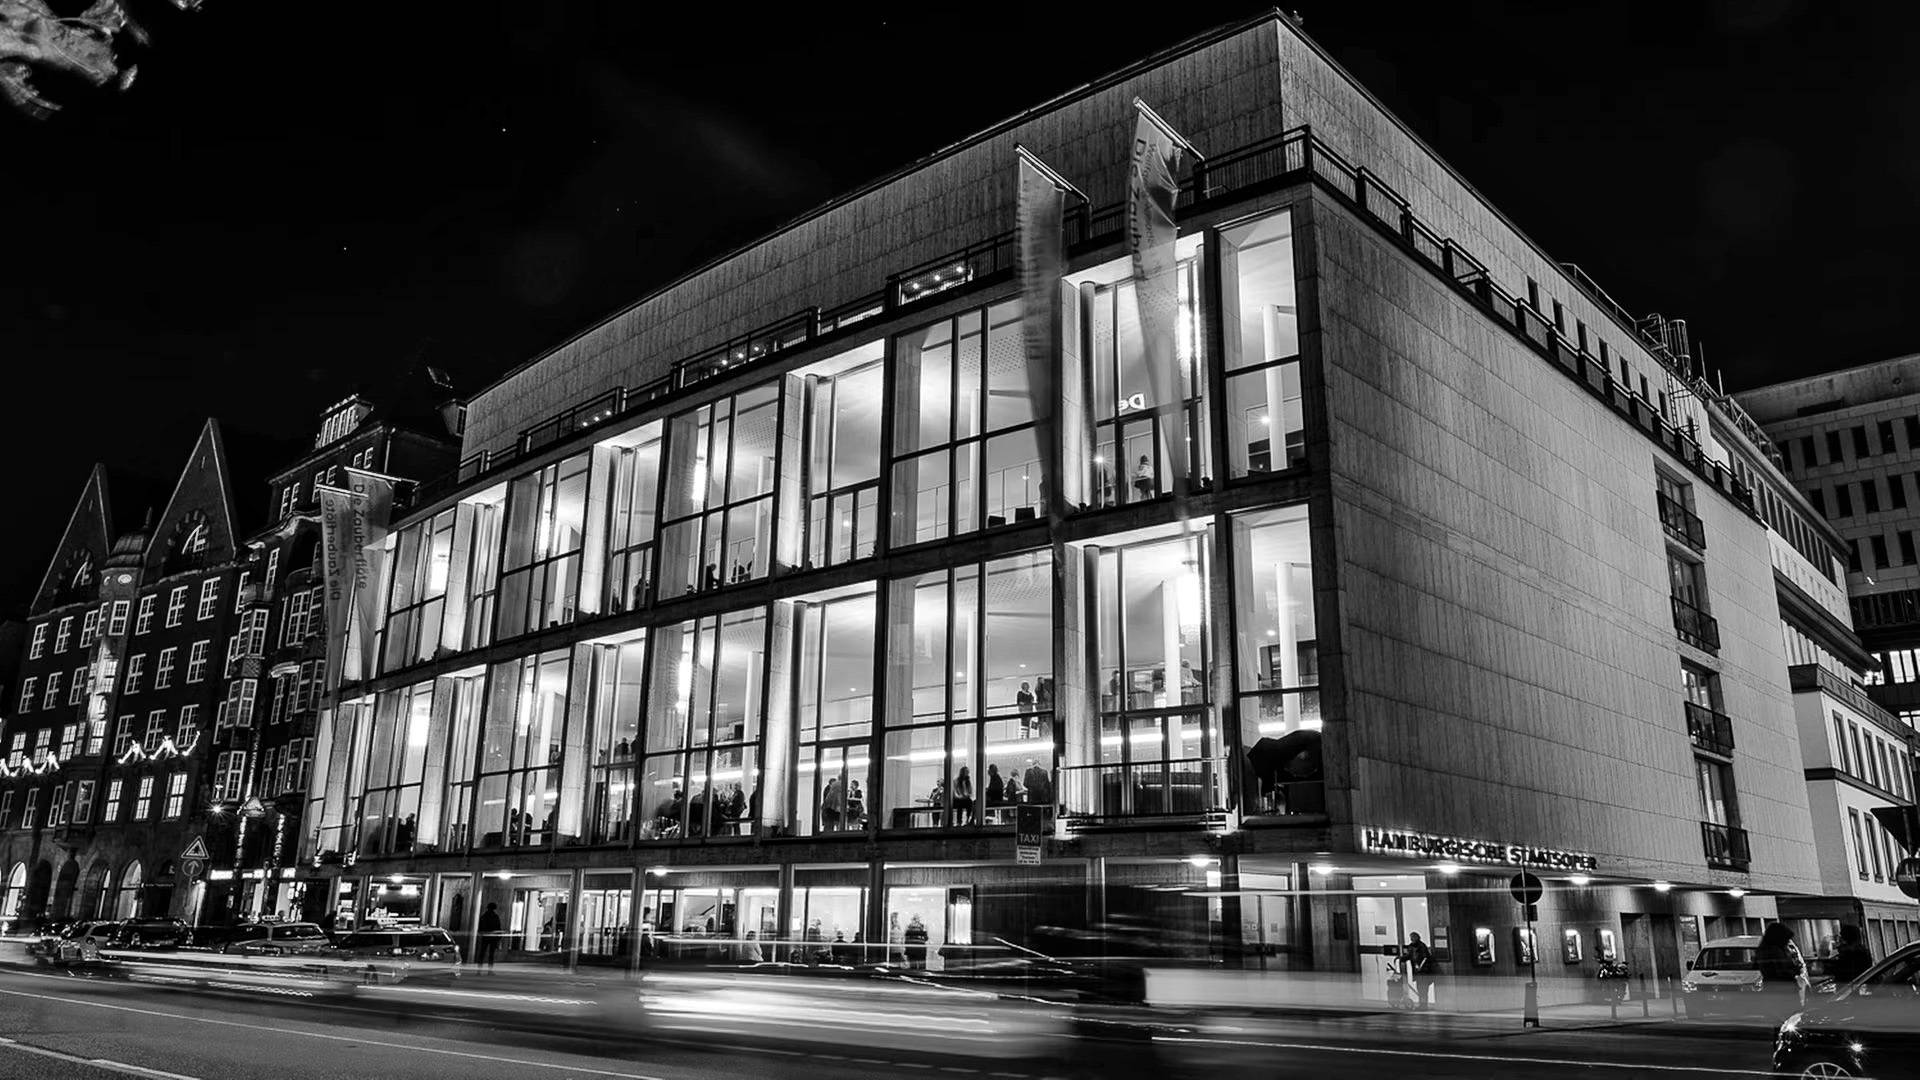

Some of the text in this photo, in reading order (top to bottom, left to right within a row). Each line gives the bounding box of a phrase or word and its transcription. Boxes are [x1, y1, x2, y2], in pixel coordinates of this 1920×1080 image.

[353, 483, 365, 507] Die
[1019, 833, 1040, 844] TAXI
[1365, 830, 1598, 871] HAMBURGISCHE STAATSOPER
